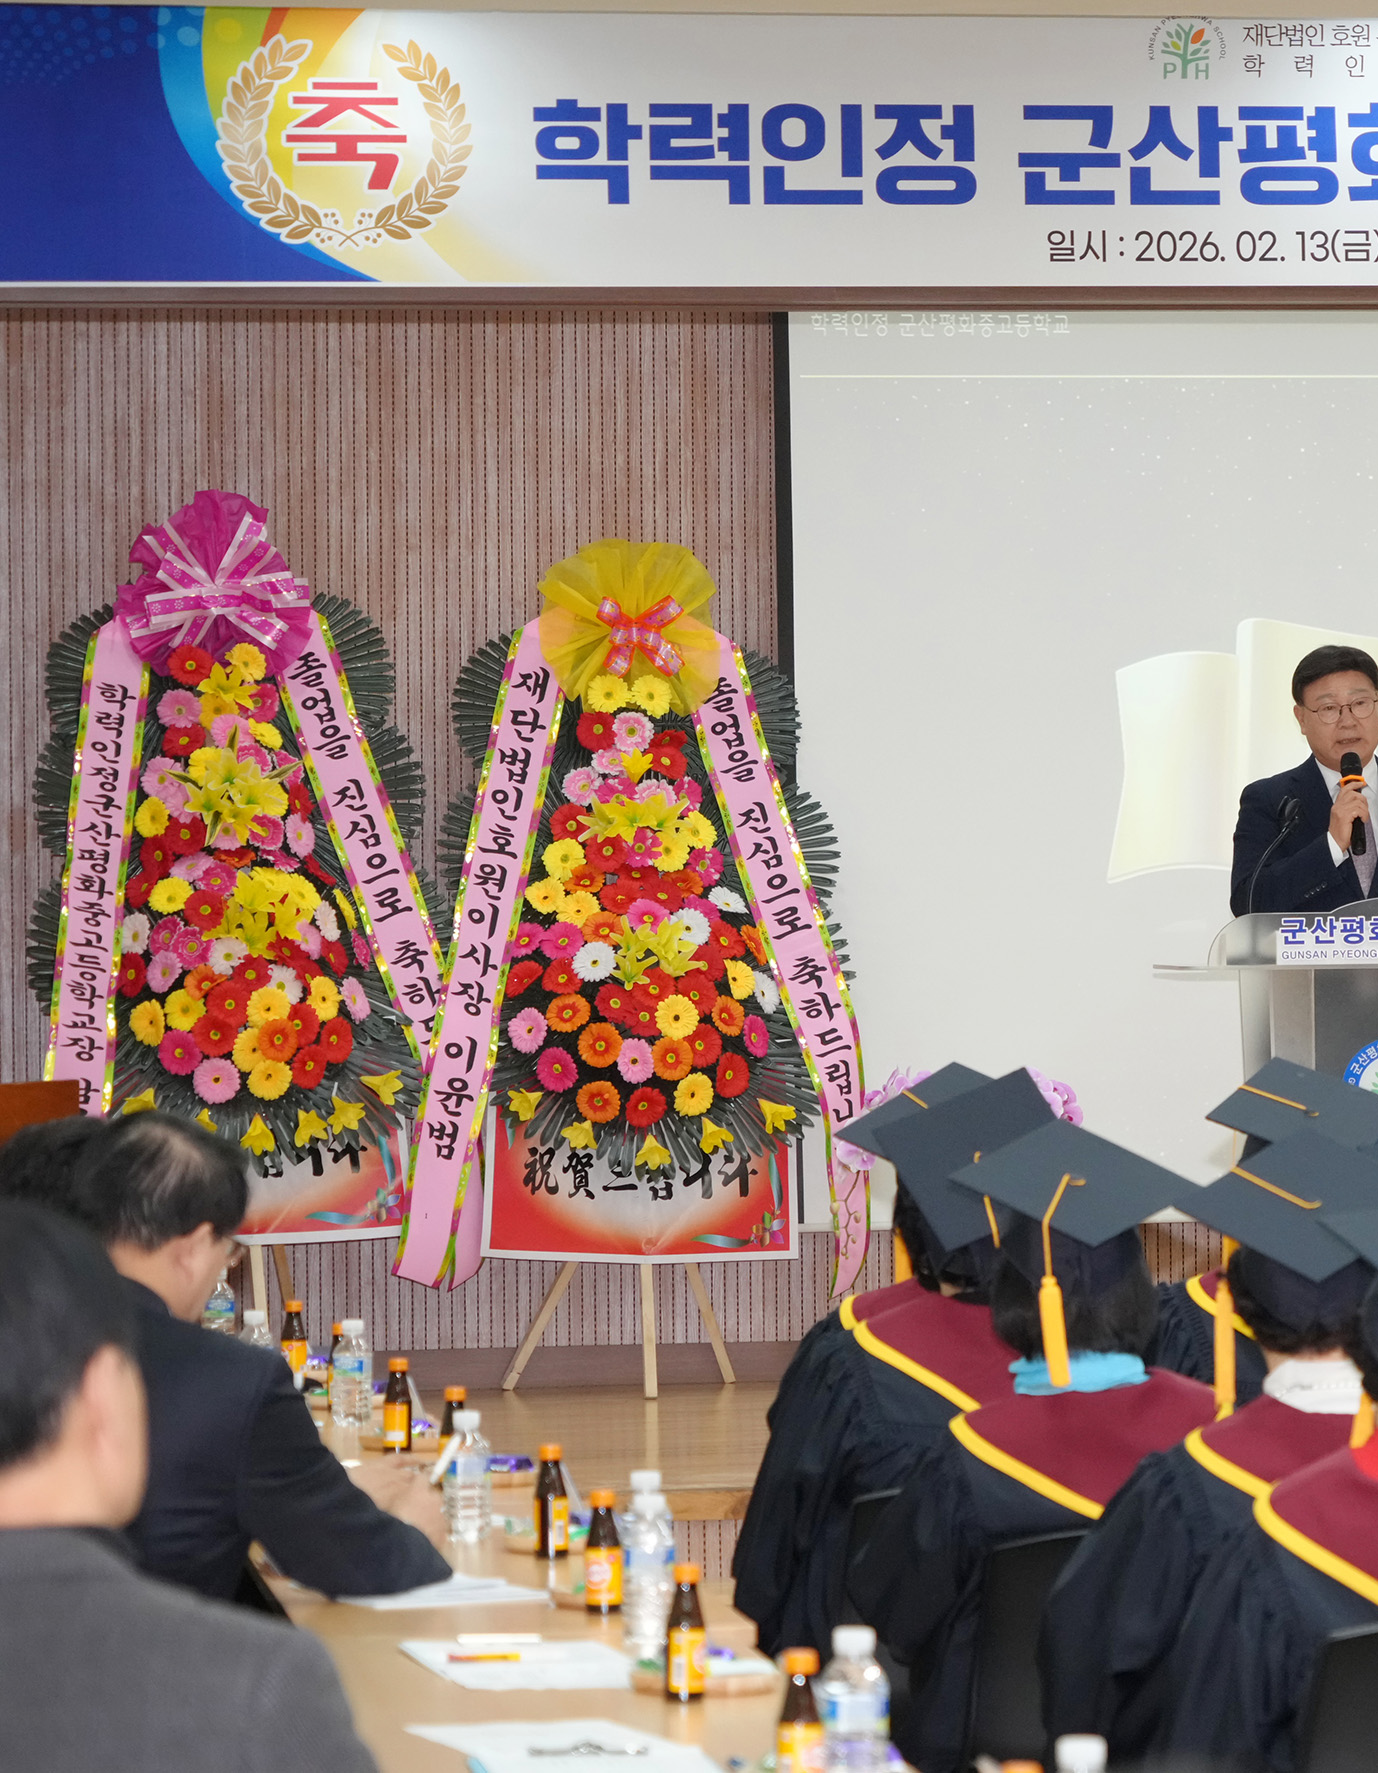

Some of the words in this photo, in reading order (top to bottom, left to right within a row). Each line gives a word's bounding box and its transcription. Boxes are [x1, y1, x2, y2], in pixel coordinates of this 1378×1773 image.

[1243, 23, 1325, 47] 재단법인
[1331, 24, 1371, 47] 호원
[287, 82, 407, 190] 축
[534, 99, 976, 205] 학력인정
[1047, 230, 1106, 262] 일시
[1135, 231, 1225, 262] 2026.
[1237, 230, 1285, 262] 02.
[811, 312, 889, 337] 학력인정
[899, 312, 1071, 338] 군산평화중고등학교
[288, 651, 352, 760] 졸업을
[331, 777, 414, 924] 진심으로
[703, 676, 759, 783] 졸업을
[735, 801, 813, 942] 진심으로
[1281, 949, 1328, 960] GUNSAN
[425, 1035, 478, 1161] 이윤범
